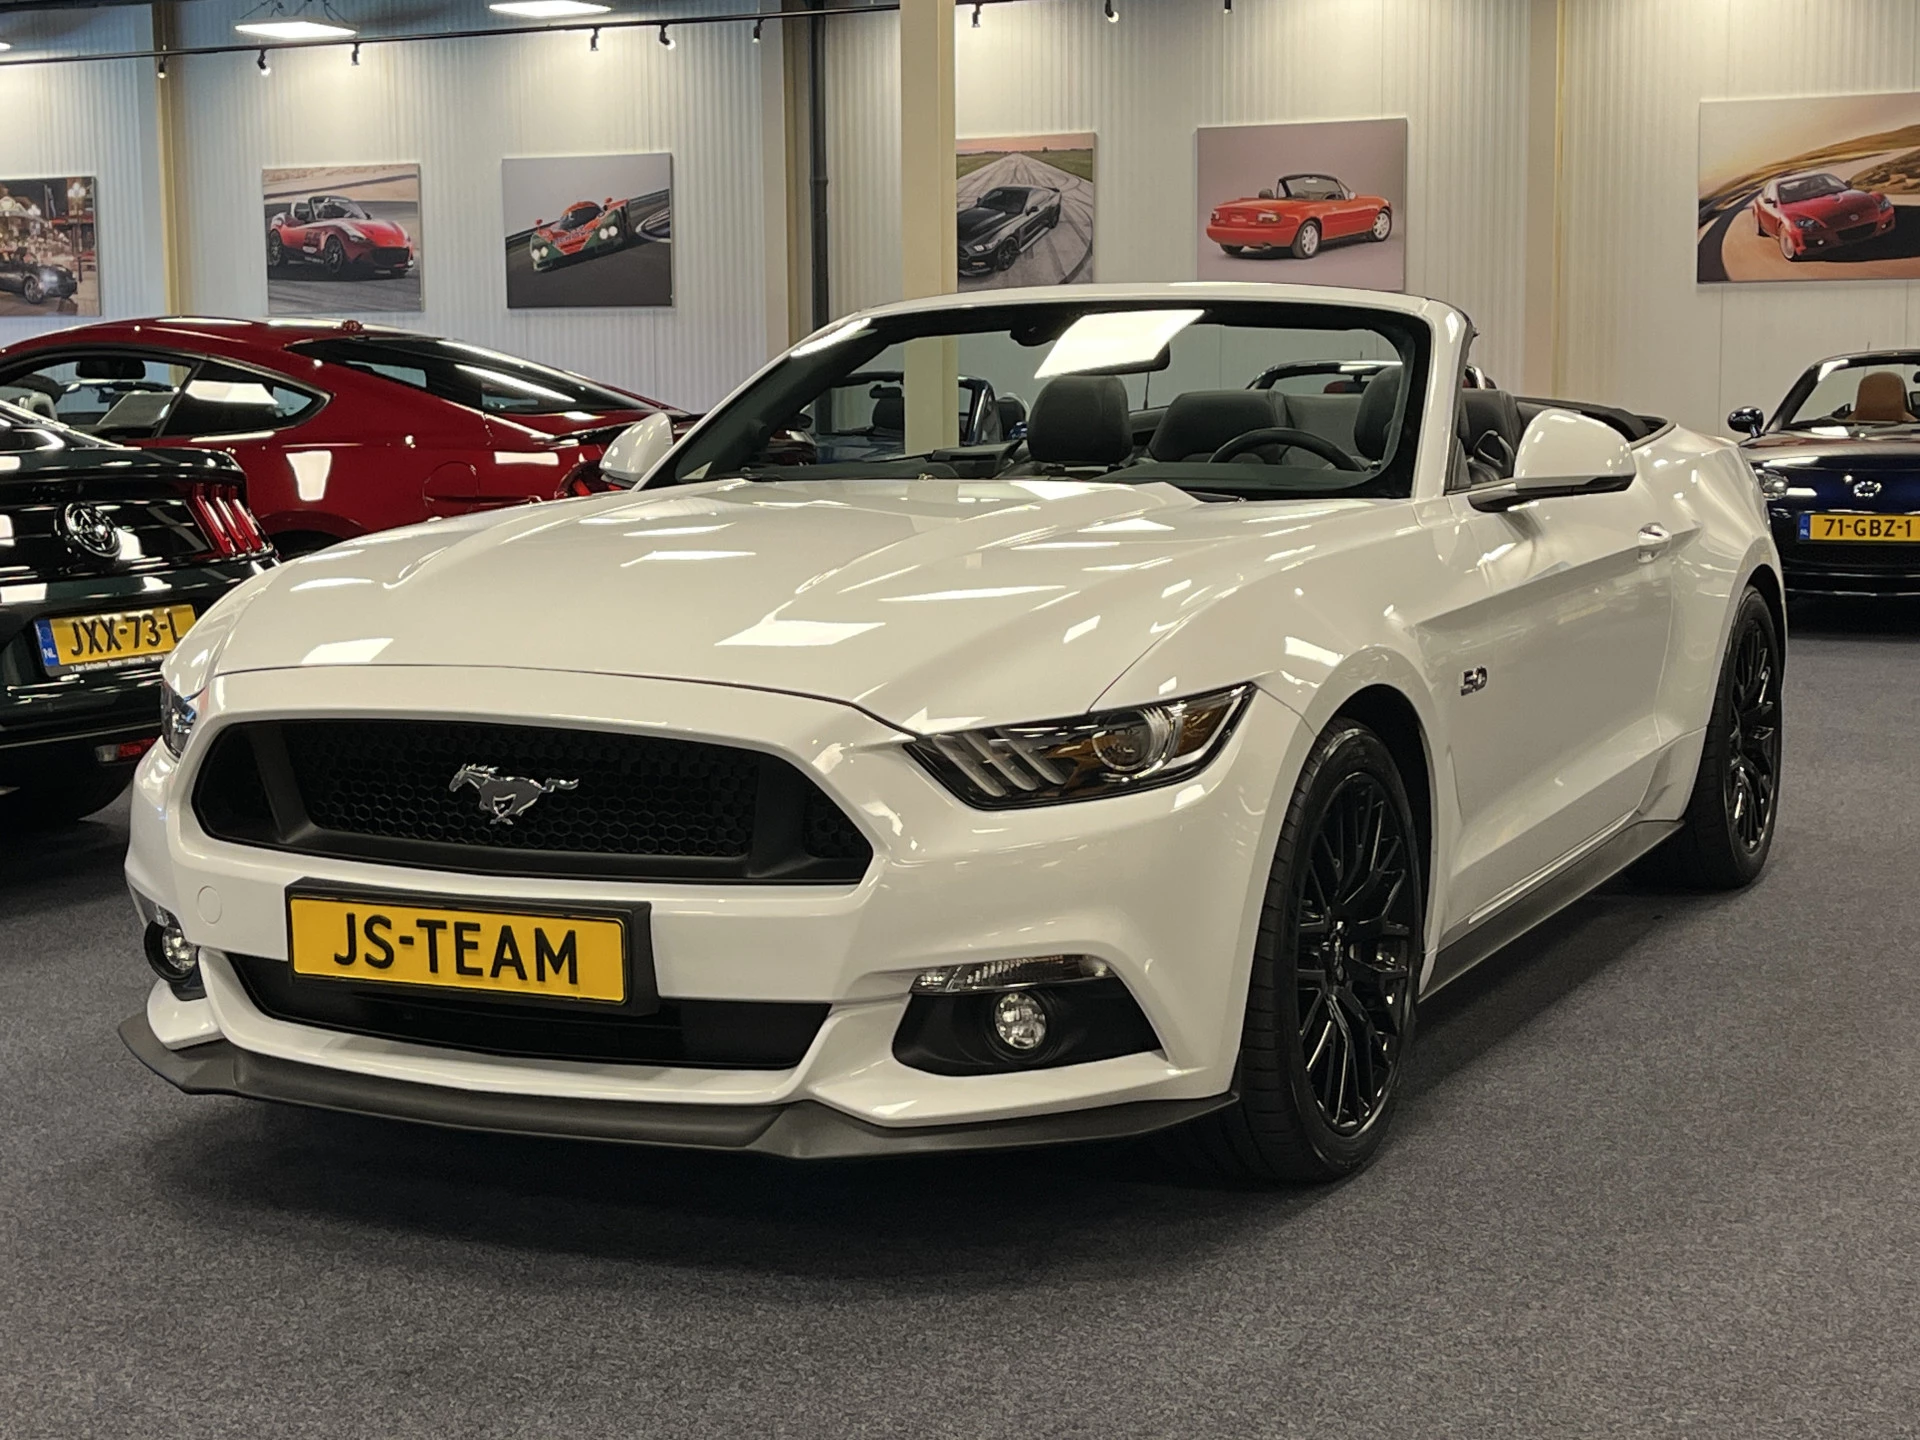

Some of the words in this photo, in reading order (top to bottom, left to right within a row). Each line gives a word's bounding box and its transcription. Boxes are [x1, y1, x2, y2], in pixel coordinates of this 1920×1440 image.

[1824, 519, 1911, 537] 71-GBZ-1
[71, 611, 183, 656] JXX-73-L
[43, 648, 57, 659] NL
[334, 912, 579, 985] JS-TEAM
